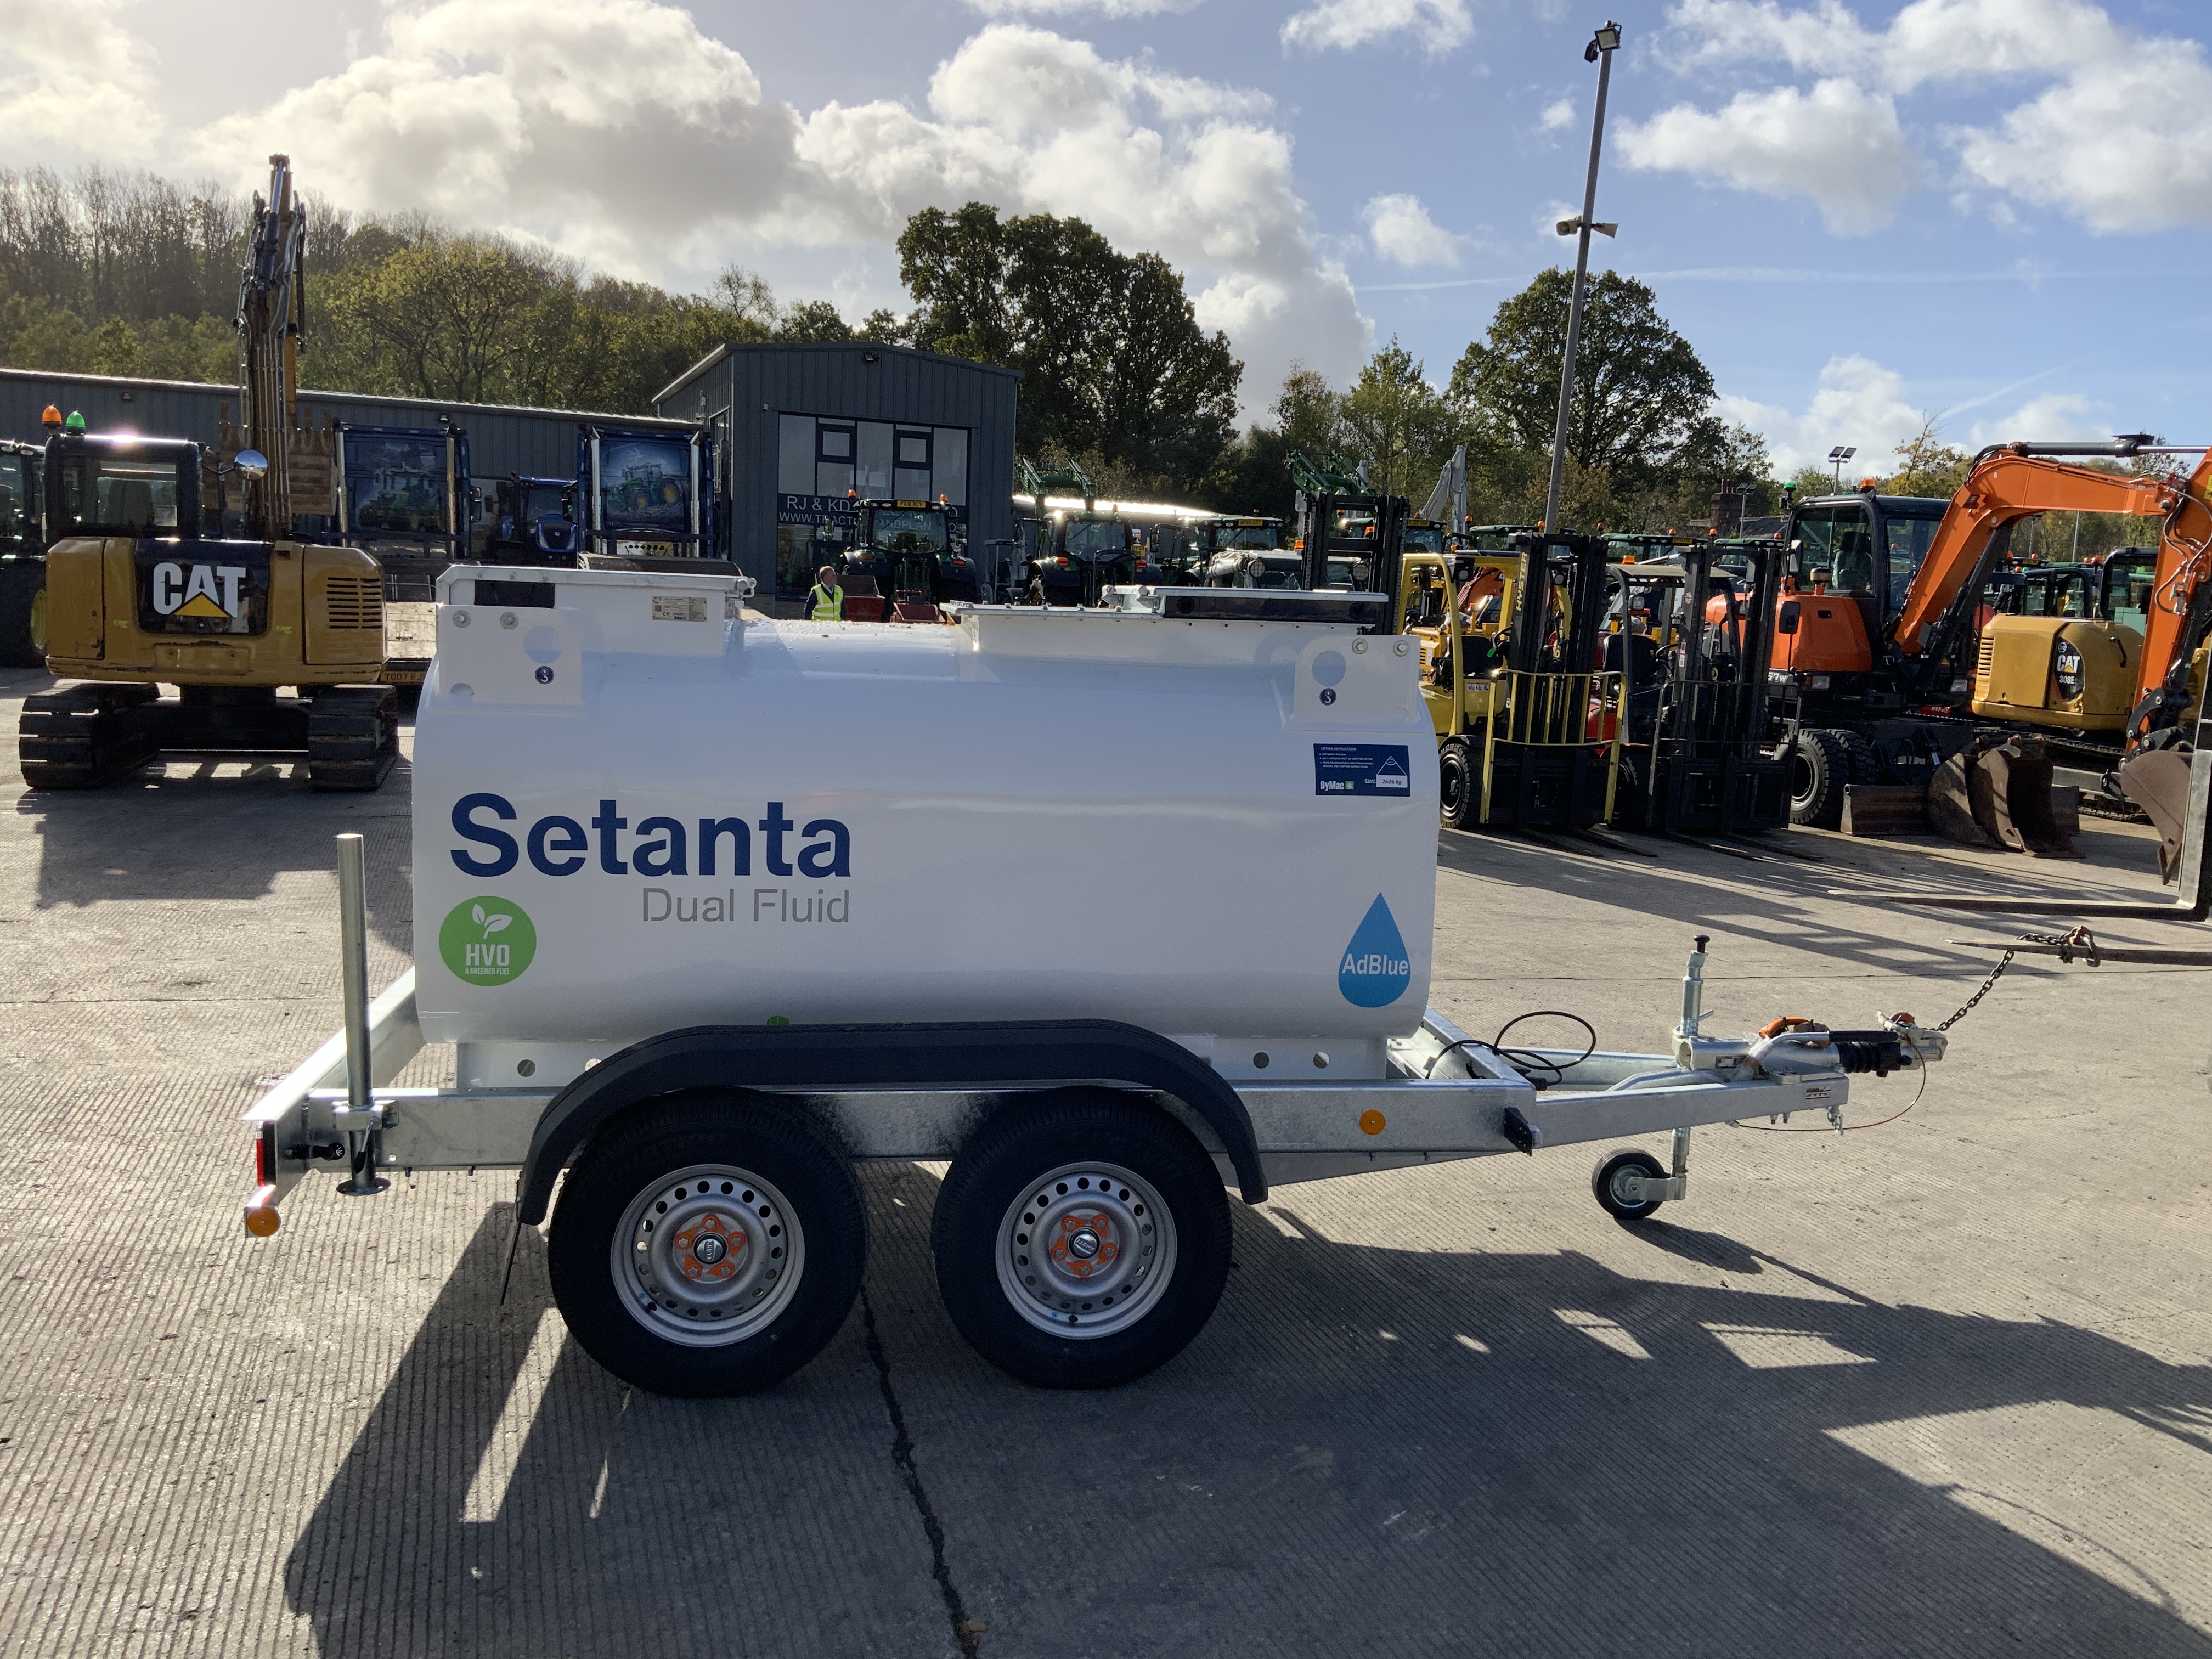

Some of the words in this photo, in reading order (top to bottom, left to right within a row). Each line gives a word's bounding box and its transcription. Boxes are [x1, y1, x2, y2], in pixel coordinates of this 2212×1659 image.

[787, 496, 807, 510] RJ
[812, 498, 822, 511] &
[828, 499, 850, 512] KD
[153, 562, 246, 618] CAT
[1516, 552, 1528, 611] HYSTER
[2057, 654, 2080, 673] CAT
[1320, 780, 1344, 791] DyMac
[450, 793, 851, 878] Setanta
[642, 888, 735, 922] Dual
[754, 888, 850, 923] Fluid
[466, 944, 510, 966] HVO
[1342, 953, 1409, 975] AdBlue
